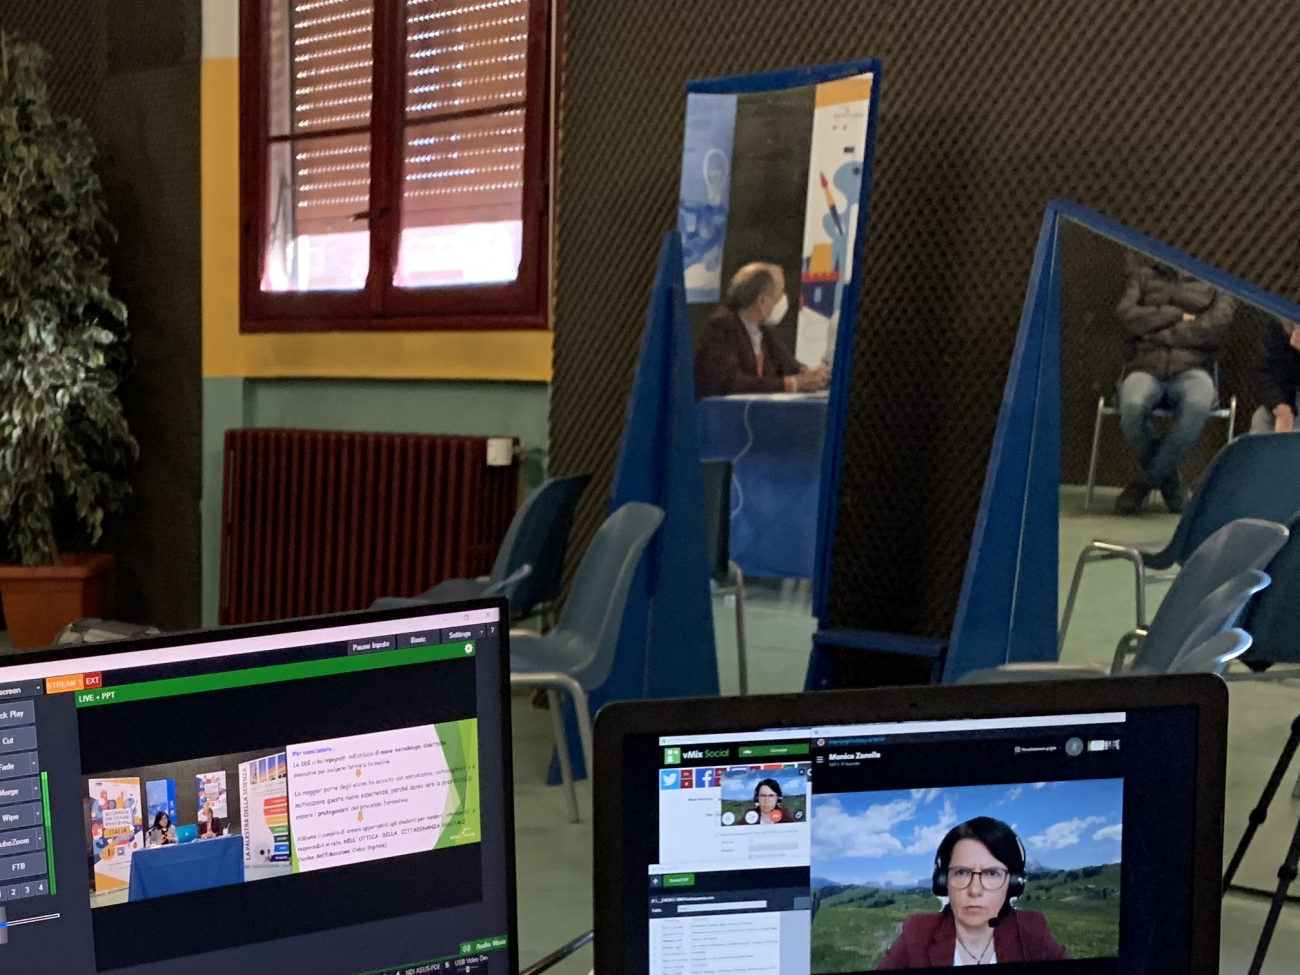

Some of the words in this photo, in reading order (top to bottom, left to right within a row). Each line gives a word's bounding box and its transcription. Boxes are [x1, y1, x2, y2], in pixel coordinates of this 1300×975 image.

[352, 642, 370, 652] Pause
[371, 639, 390, 650] Inputs
[410, 635, 426, 644] Basic
[449, 630, 471, 640] Settings
[85, 676, 100, 686] EXT
[78, 694, 94, 703] LIVE
[100, 691, 116, 700] PPT
[9, 709, 24, 719] Play
[2, 737, 14, 745] Cut
[683, 750, 703, 759] vMix
[704, 749, 730, 758] Social
[829, 752, 854, 761] Monica
[855, 750, 881, 760] Zanella
[1, 813, 19, 823] Wipe
[11, 862, 25, 871] FTB
